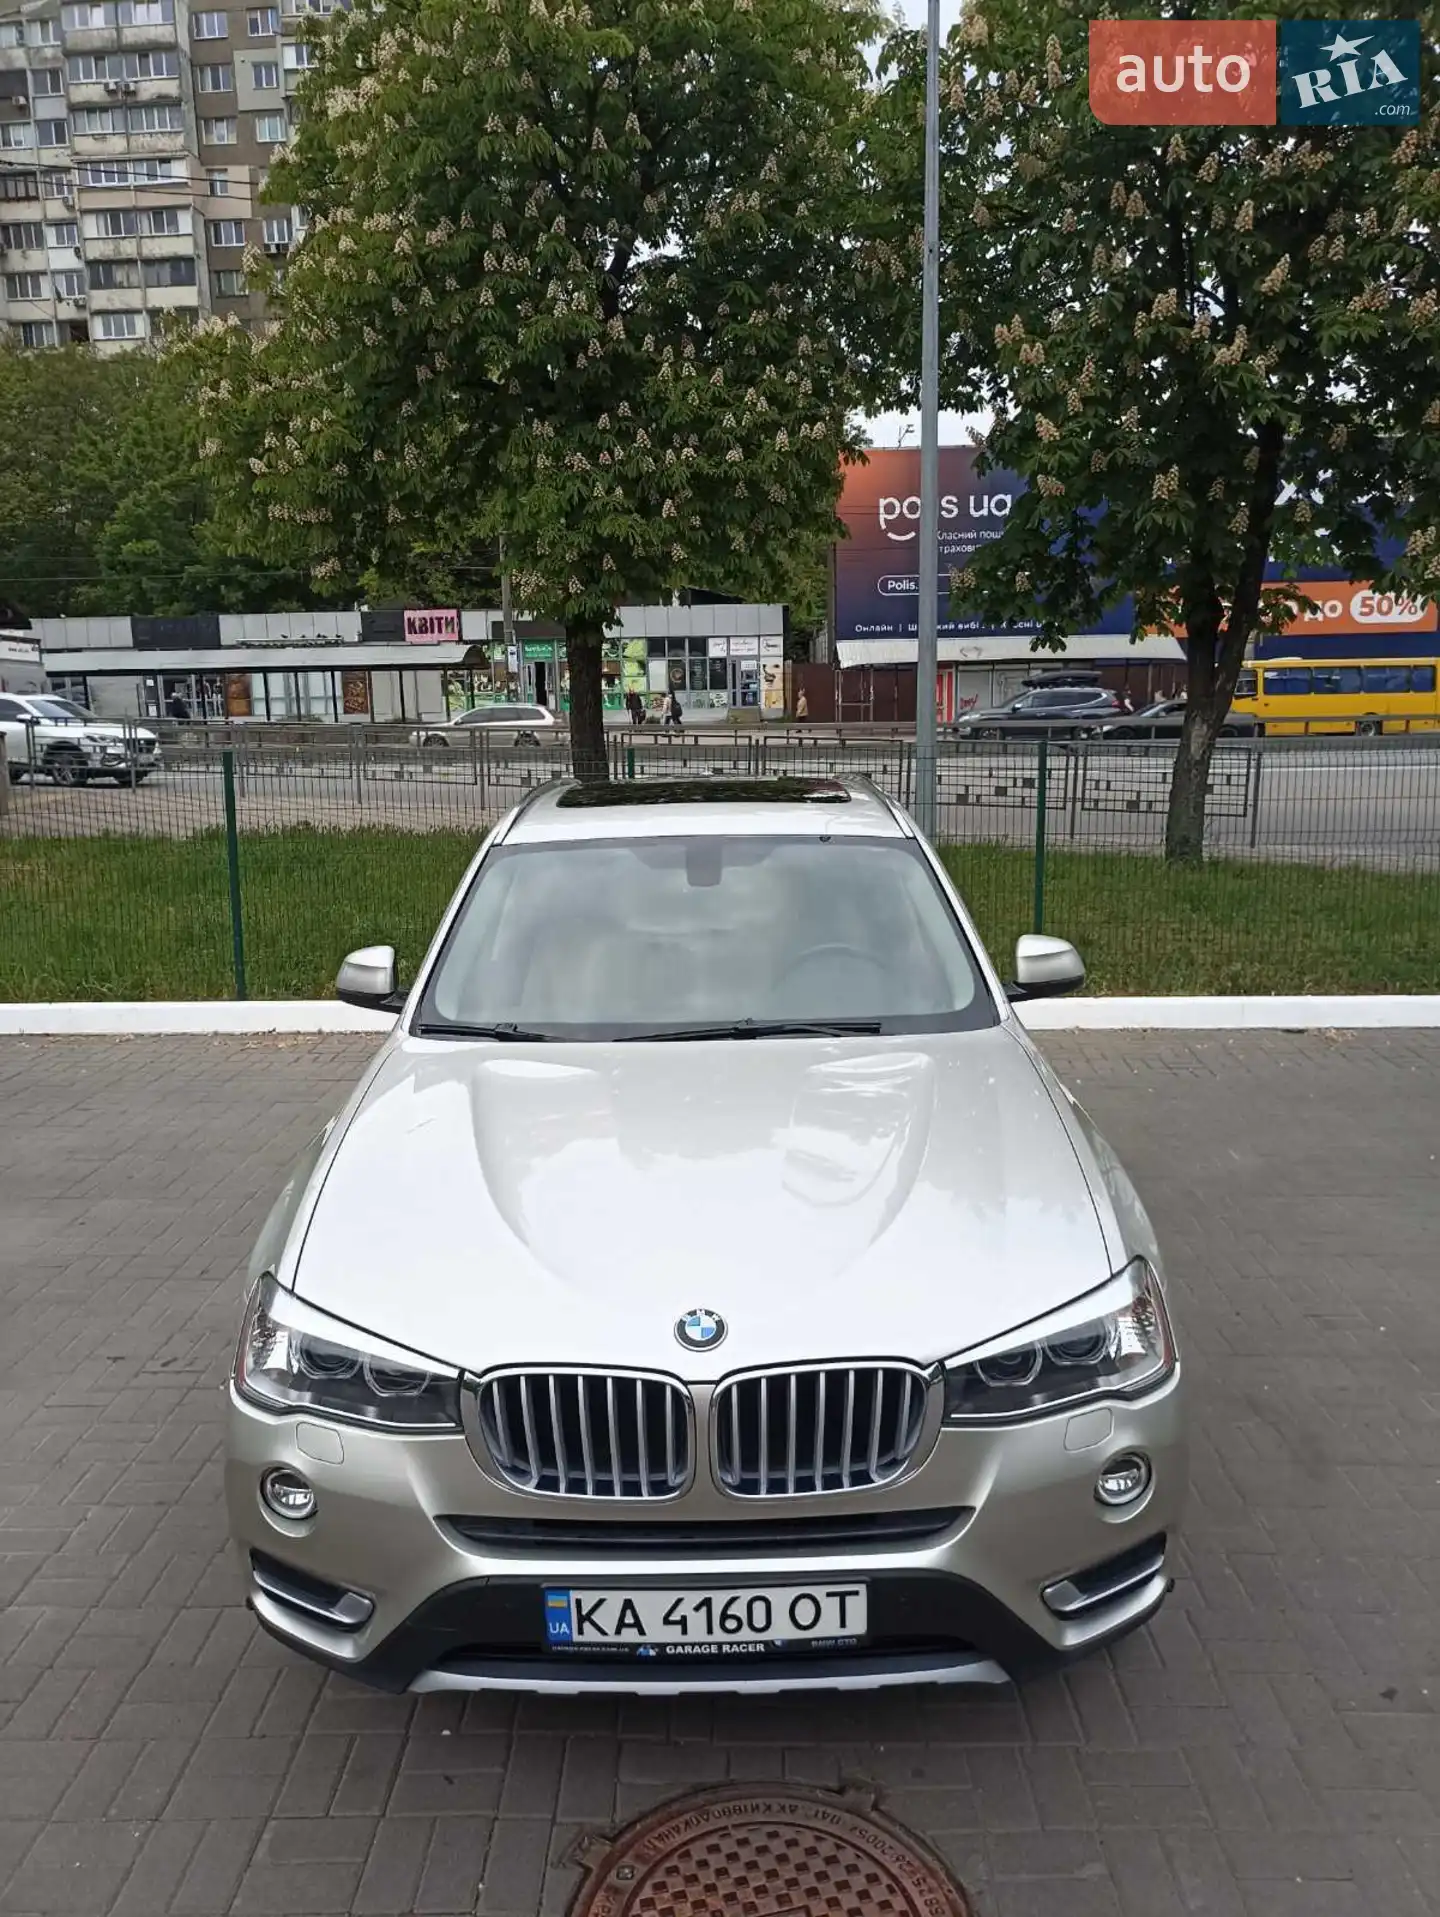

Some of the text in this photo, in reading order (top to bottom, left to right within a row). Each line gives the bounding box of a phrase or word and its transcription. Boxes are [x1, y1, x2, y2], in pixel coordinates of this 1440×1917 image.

[879, 494, 1012, 531] pos ua
[980, 530, 1004, 539] пош
[887, 580, 919, 591] Polis.
[1358, 595, 1418, 617] 50%
[407, 616, 456, 635] КВІТИ
[855, 623, 893, 632] Онлайн
[575, 1589, 860, 1637] KA 4160 OT
[549, 1622, 570, 1636] UA
[665, 1643, 765, 1655] GARAGE RACER
